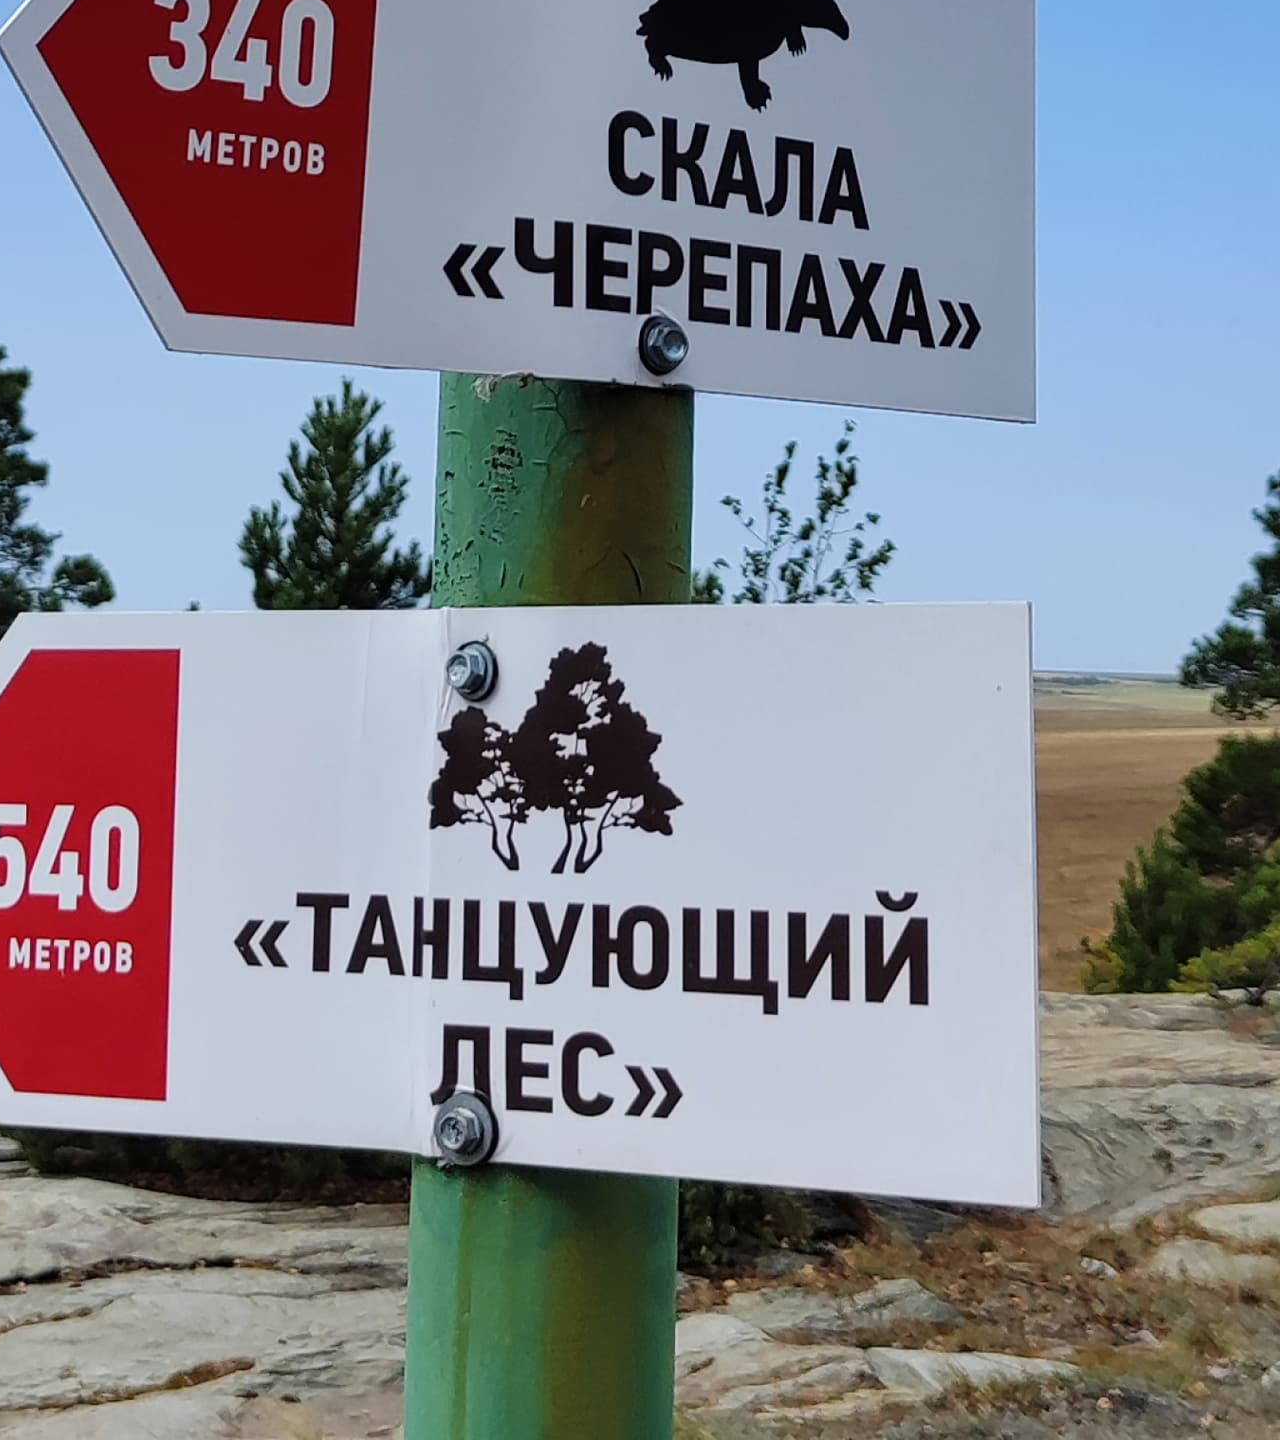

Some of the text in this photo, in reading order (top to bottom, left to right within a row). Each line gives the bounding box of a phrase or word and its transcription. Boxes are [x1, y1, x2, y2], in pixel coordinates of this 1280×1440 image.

[187, 128, 325, 176] МЕТРОВ
[608, 110, 870, 231] СКАЛА
[442, 217, 982, 350] «ЧЕРЕПАХА»
[8, 937, 134, 973] МЕТРОВ
[233, 890, 929, 1015] «ТАНЦУЮЩИЙ
[430, 1023, 683, 1118] ЛЕС»
